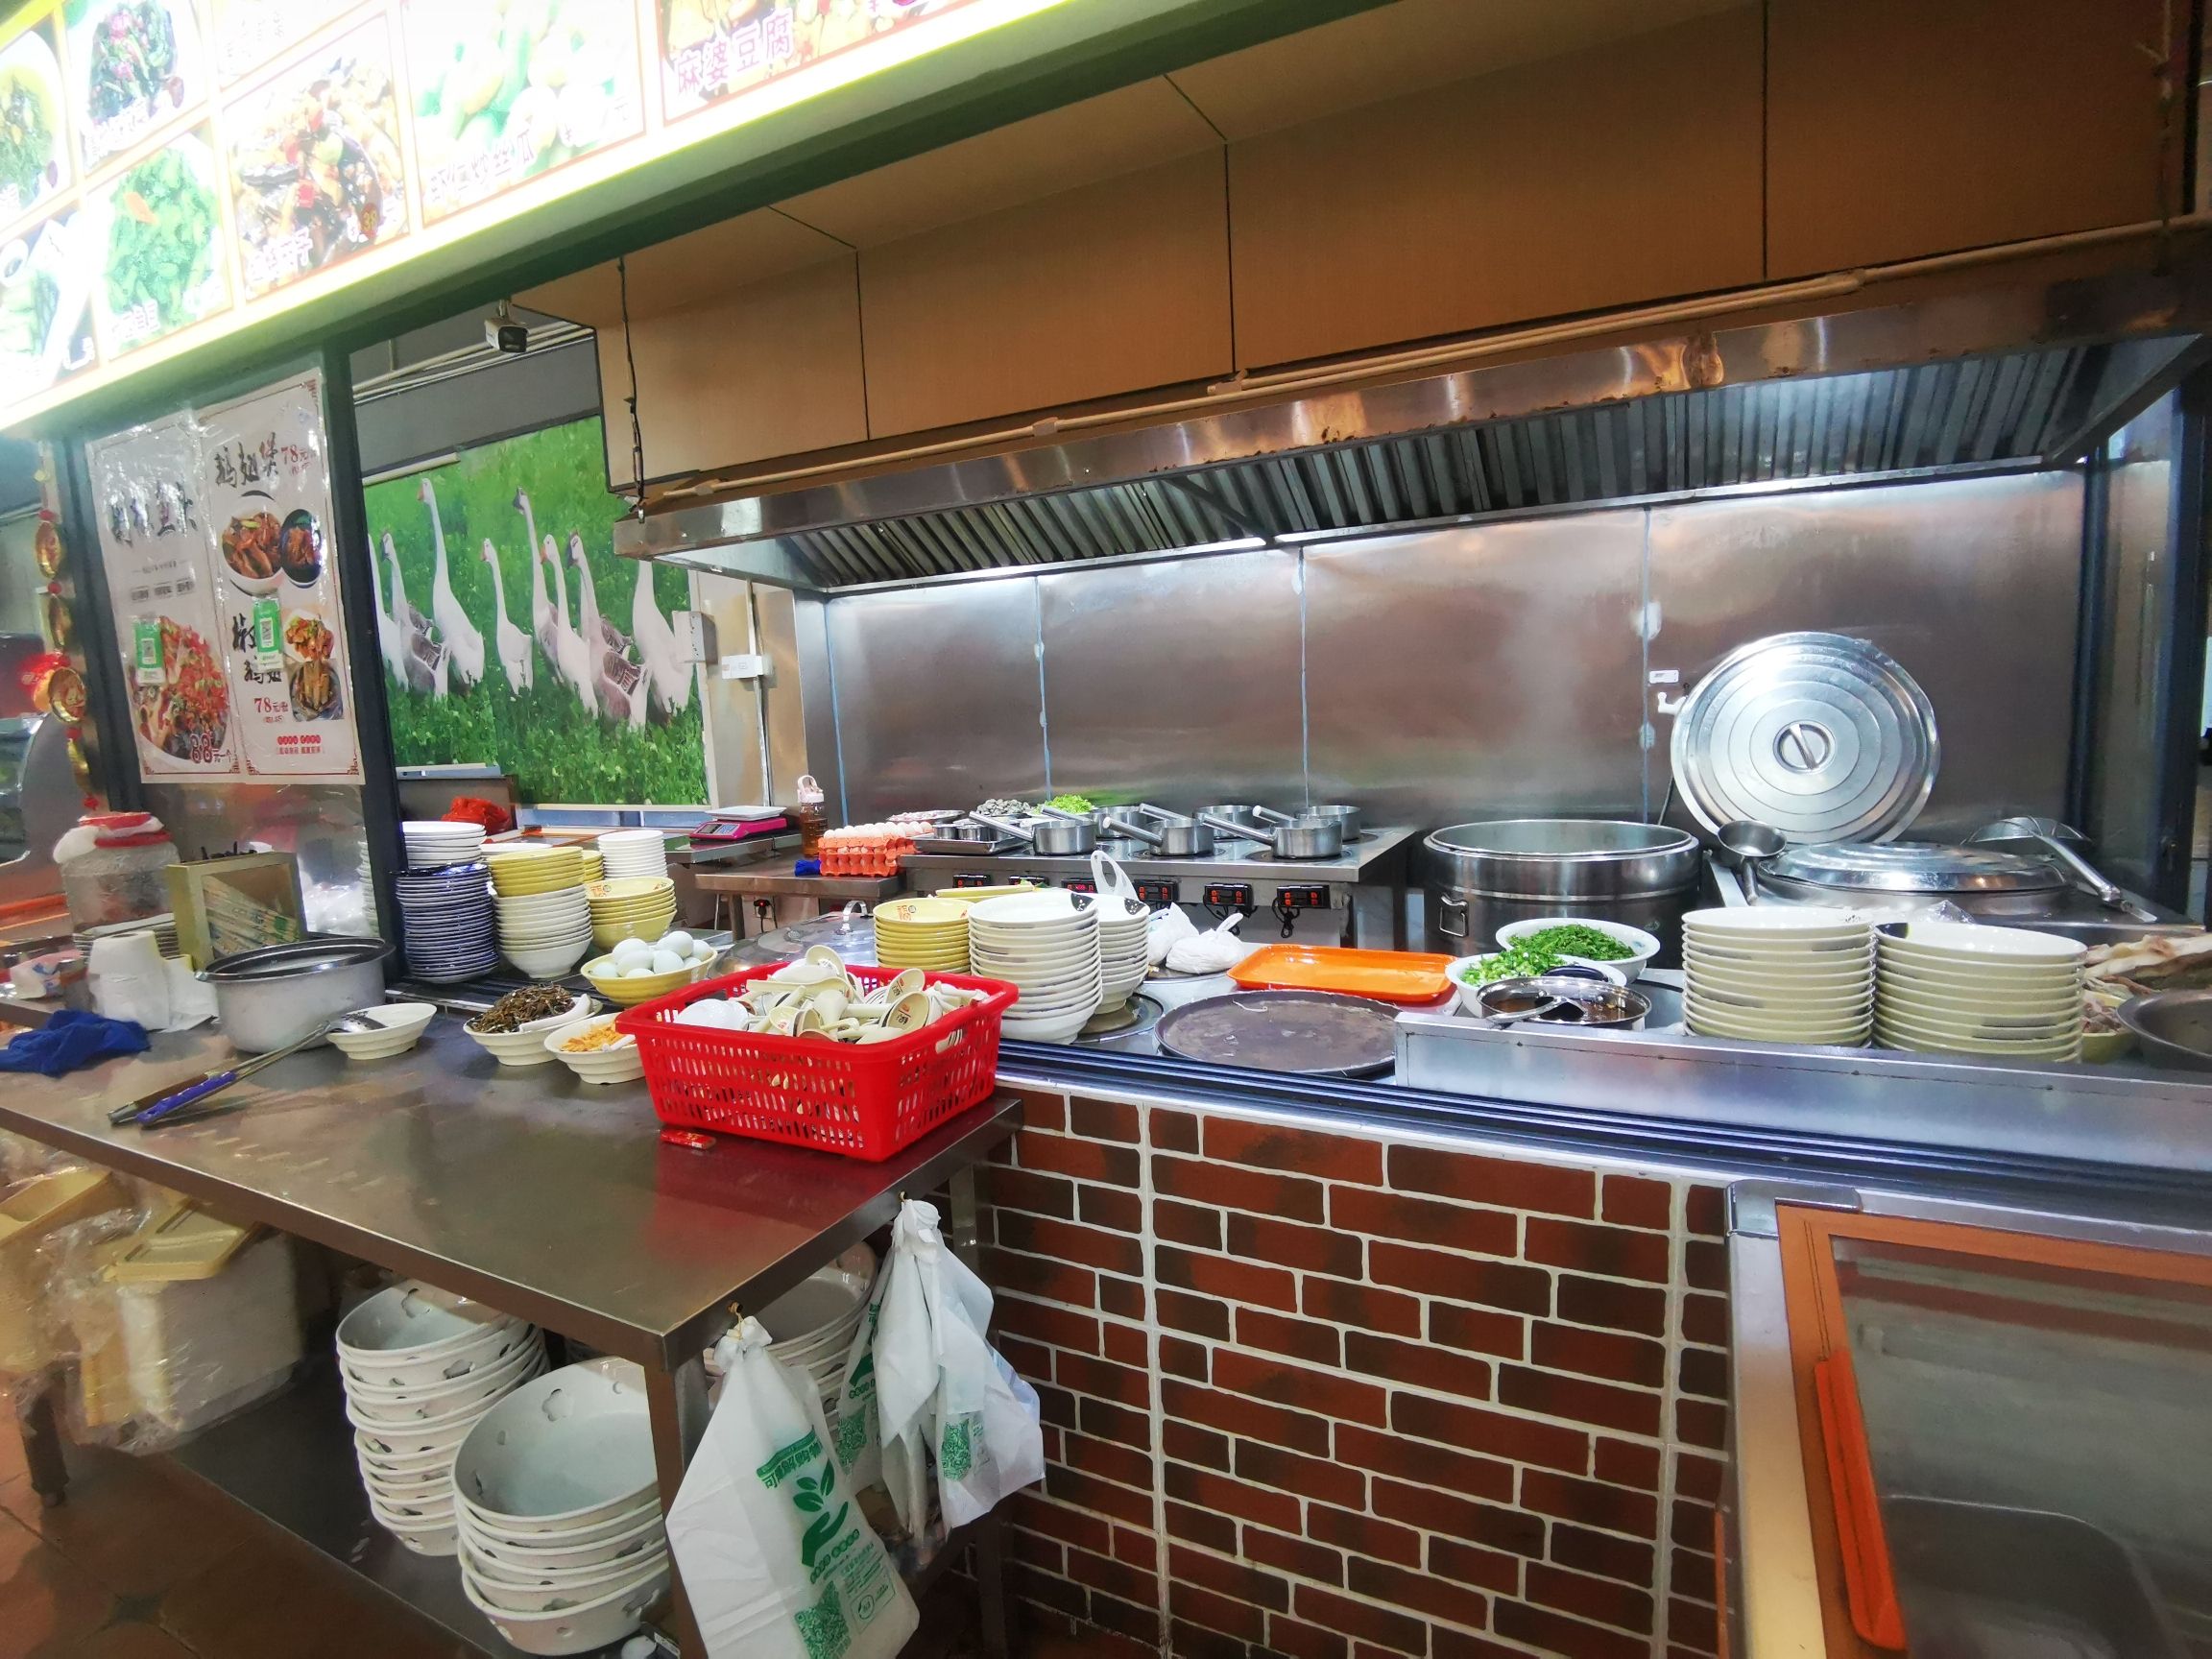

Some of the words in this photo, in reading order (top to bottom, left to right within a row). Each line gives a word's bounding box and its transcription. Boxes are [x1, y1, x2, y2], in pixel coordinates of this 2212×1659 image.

[676, 13, 793, 94] 麻婆豆腐
[430, 129, 536, 203] 虾仁炒丝瓜
